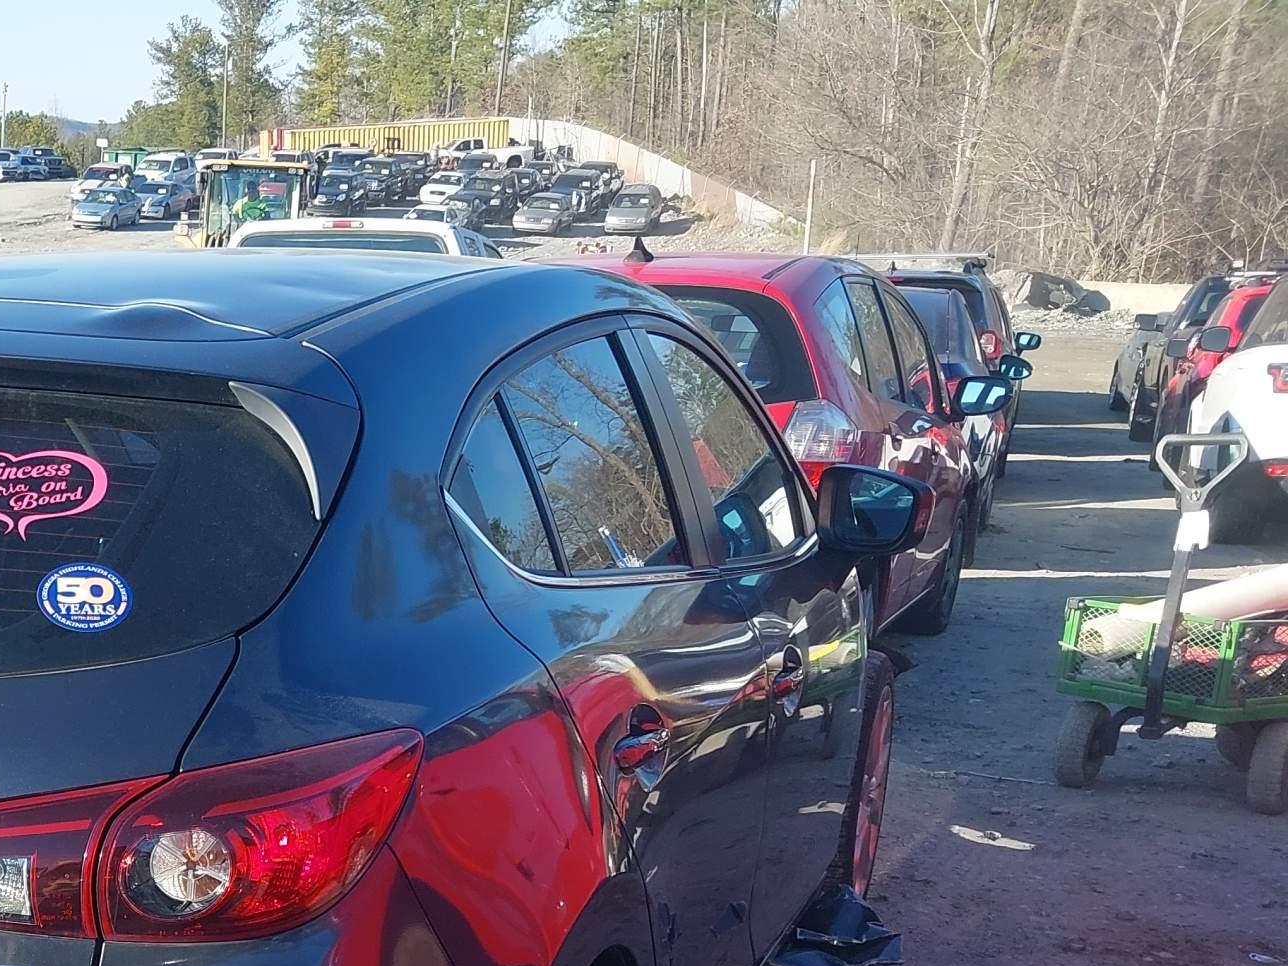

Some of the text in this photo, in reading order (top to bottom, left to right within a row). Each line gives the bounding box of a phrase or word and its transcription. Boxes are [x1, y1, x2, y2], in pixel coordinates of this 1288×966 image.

[41, 480, 67, 493] on
[9, 486, 83, 511] Board
[58, 565, 109, 576] HIGHLANDS
[56, 576, 115, 604] 50
[57, 603, 116, 616] YEARS
[52, 613, 118, 629] PARKING PERMIT
